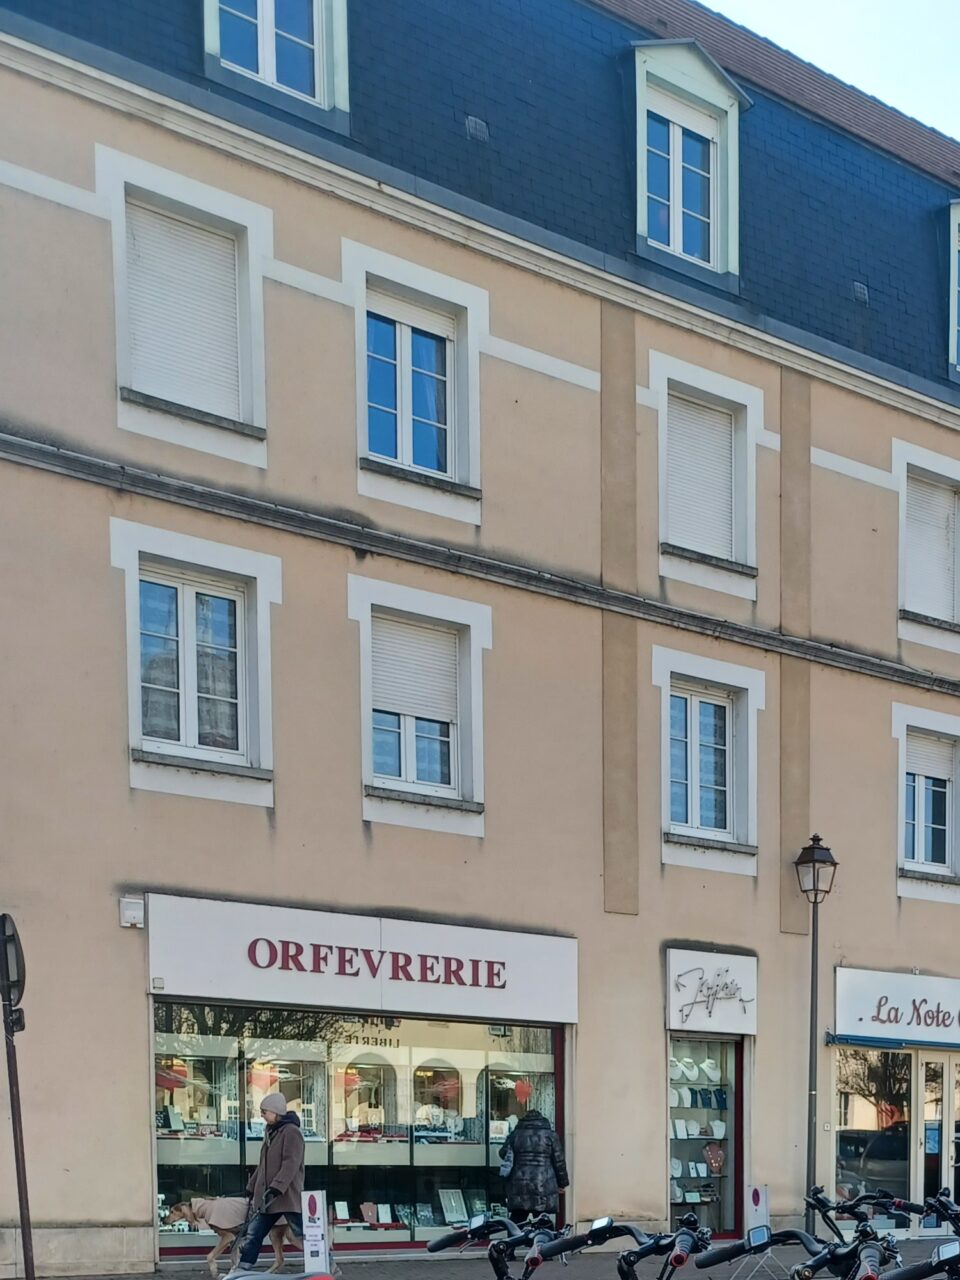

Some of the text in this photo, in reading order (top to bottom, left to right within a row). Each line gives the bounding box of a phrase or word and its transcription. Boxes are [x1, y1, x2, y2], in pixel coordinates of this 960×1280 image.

[247, 937, 507, 990] ORFEVRERIE
[872, 996, 903, 1024] La
[907, 998, 954, 1028] Note
